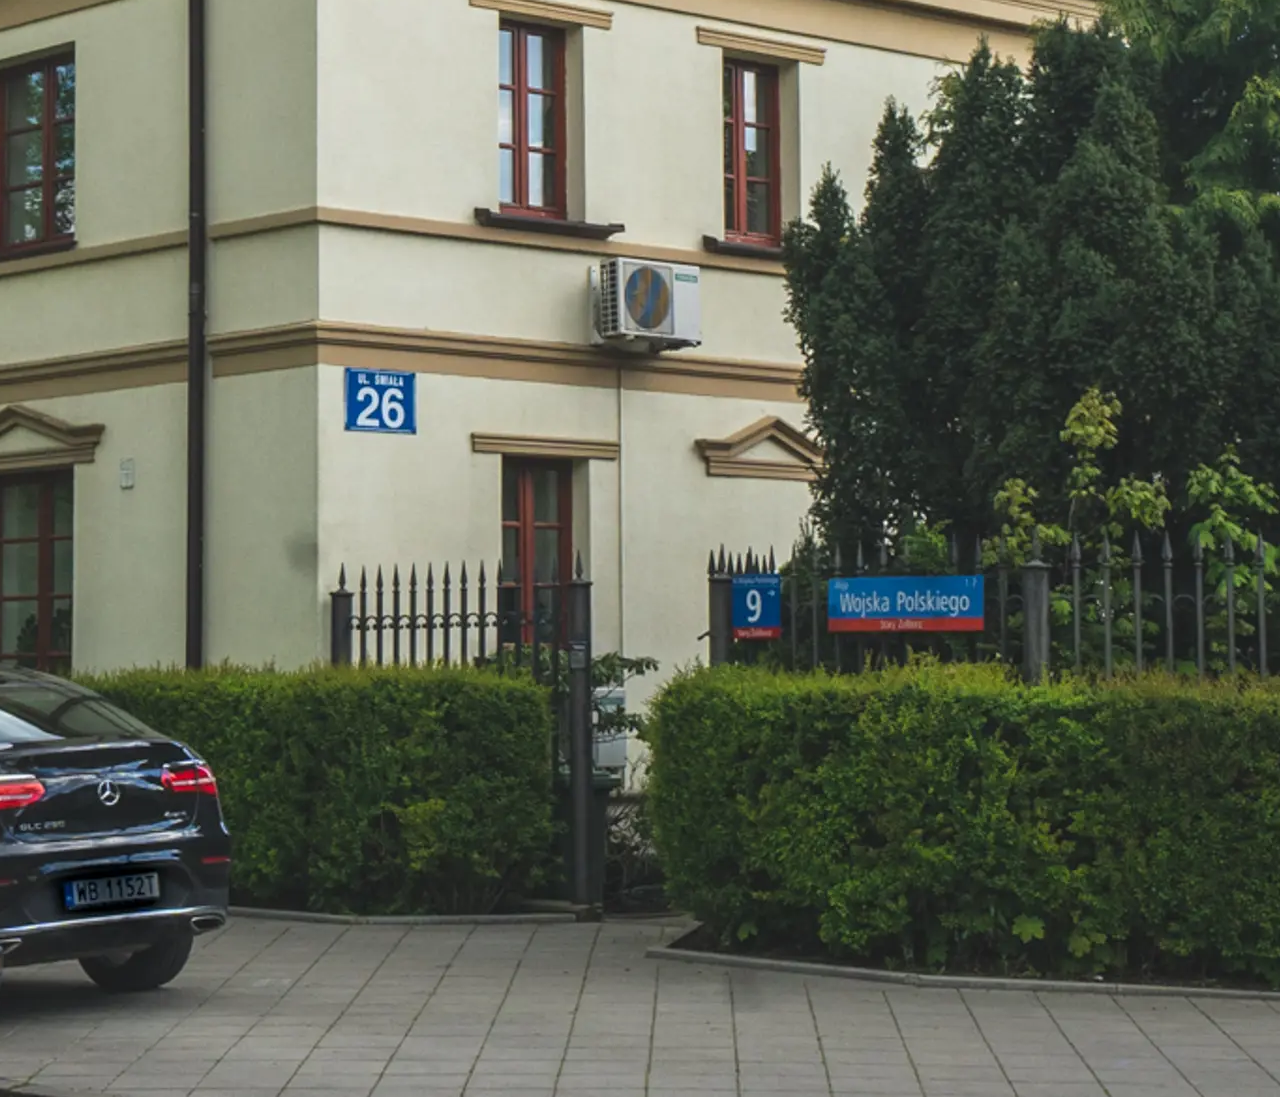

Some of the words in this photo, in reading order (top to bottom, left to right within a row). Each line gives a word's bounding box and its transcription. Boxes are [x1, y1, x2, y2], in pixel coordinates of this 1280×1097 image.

[356, 386, 405, 429] 26
[746, 589, 762, 623] 9
[840, 590, 890, 618] Wojska
[896, 589, 970, 617] Polskiego
[76, 882, 98, 902] WB
[107, 875, 154, 900] 1152T
